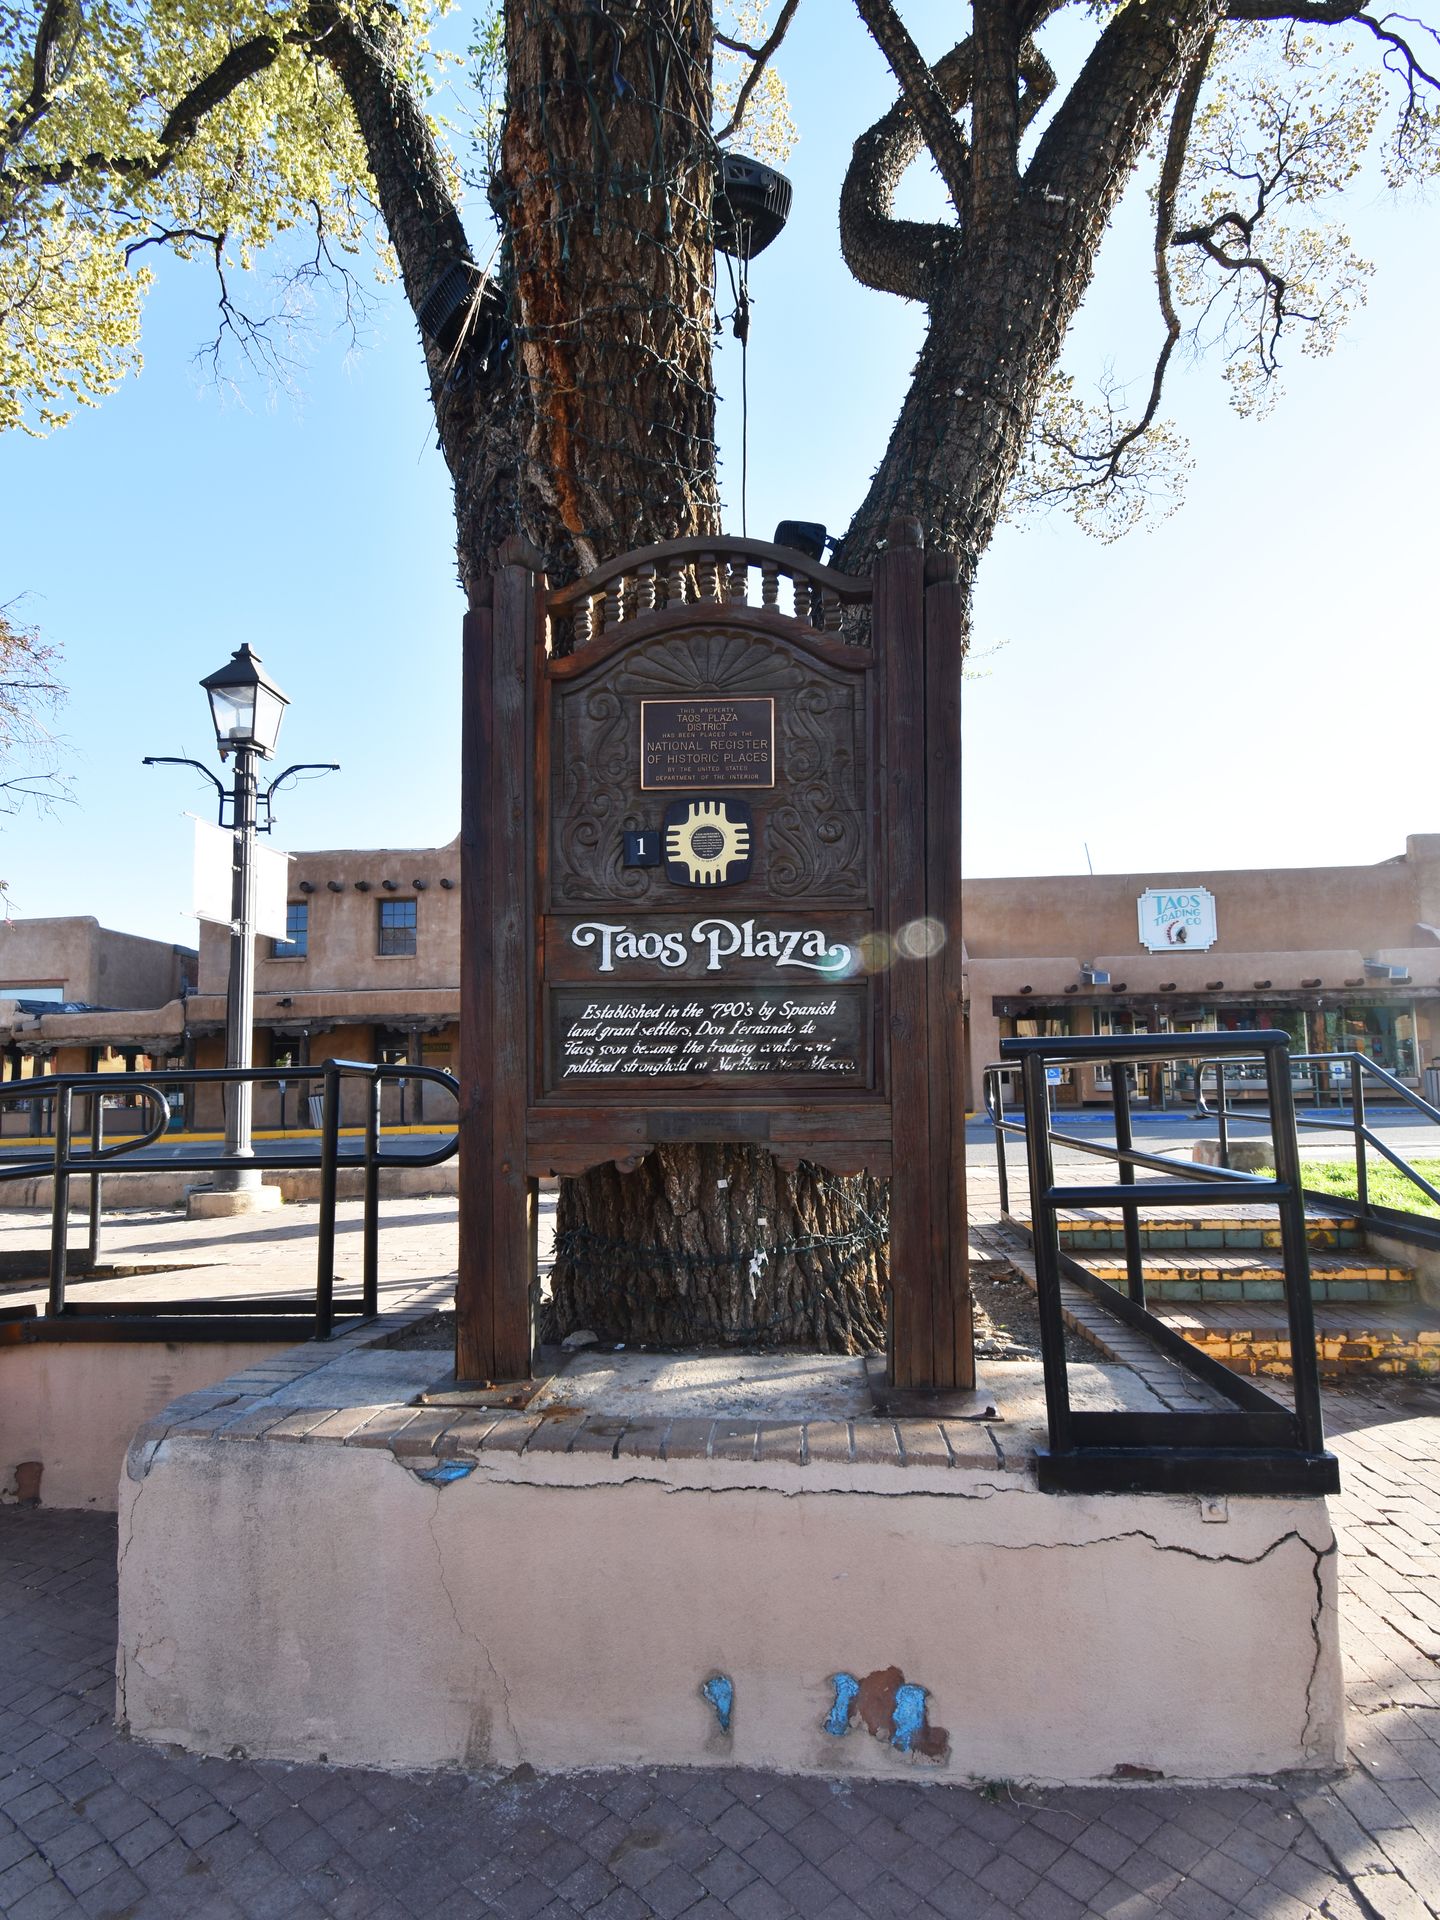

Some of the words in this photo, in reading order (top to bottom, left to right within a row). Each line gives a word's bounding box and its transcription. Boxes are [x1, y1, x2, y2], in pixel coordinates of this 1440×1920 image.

[676, 714, 700, 722] TAOS
[708, 714, 738, 722] PLAZA
[687, 722, 728, 732] DISTRICT
[647, 742, 703, 752] NATIONAL
[710, 740, 768, 750] REGISTER
[647, 754, 662, 764] OF
[667, 754, 719, 764] HISTORIC
[724, 752, 768, 762] PLACES
[636, 838, 646, 855] 1
[1152, 895, 1200, 916] TAOS
[1154, 908, 1200, 926] TRADING
[1186, 918, 1202, 926] CO
[572, 922, 688, 972] Taos
[691, 919, 851, 972] Plaza
[581, 1003, 665, 1019] Established
[664, 1004, 680, 1018] in
[681, 1002, 704, 1018] the
[758, 1000, 776, 1021] by
[779, 1000, 837, 1019] Spanish
[567, 1022, 603, 1037] land
[595, 1021, 640, 1042] grant
[640, 1021, 692, 1037] settlers,
[694, 1020, 725, 1035] Don
[729, 1020, 796, 1035] Fernando
[800, 1020, 817, 1034] de
[564, 1040, 595, 1056] Taos
[599, 1044, 628, 1056] soon
[682, 1040, 704, 1054] the
[706, 1038, 756, 1057] trading
[562, 1058, 622, 1078] political
